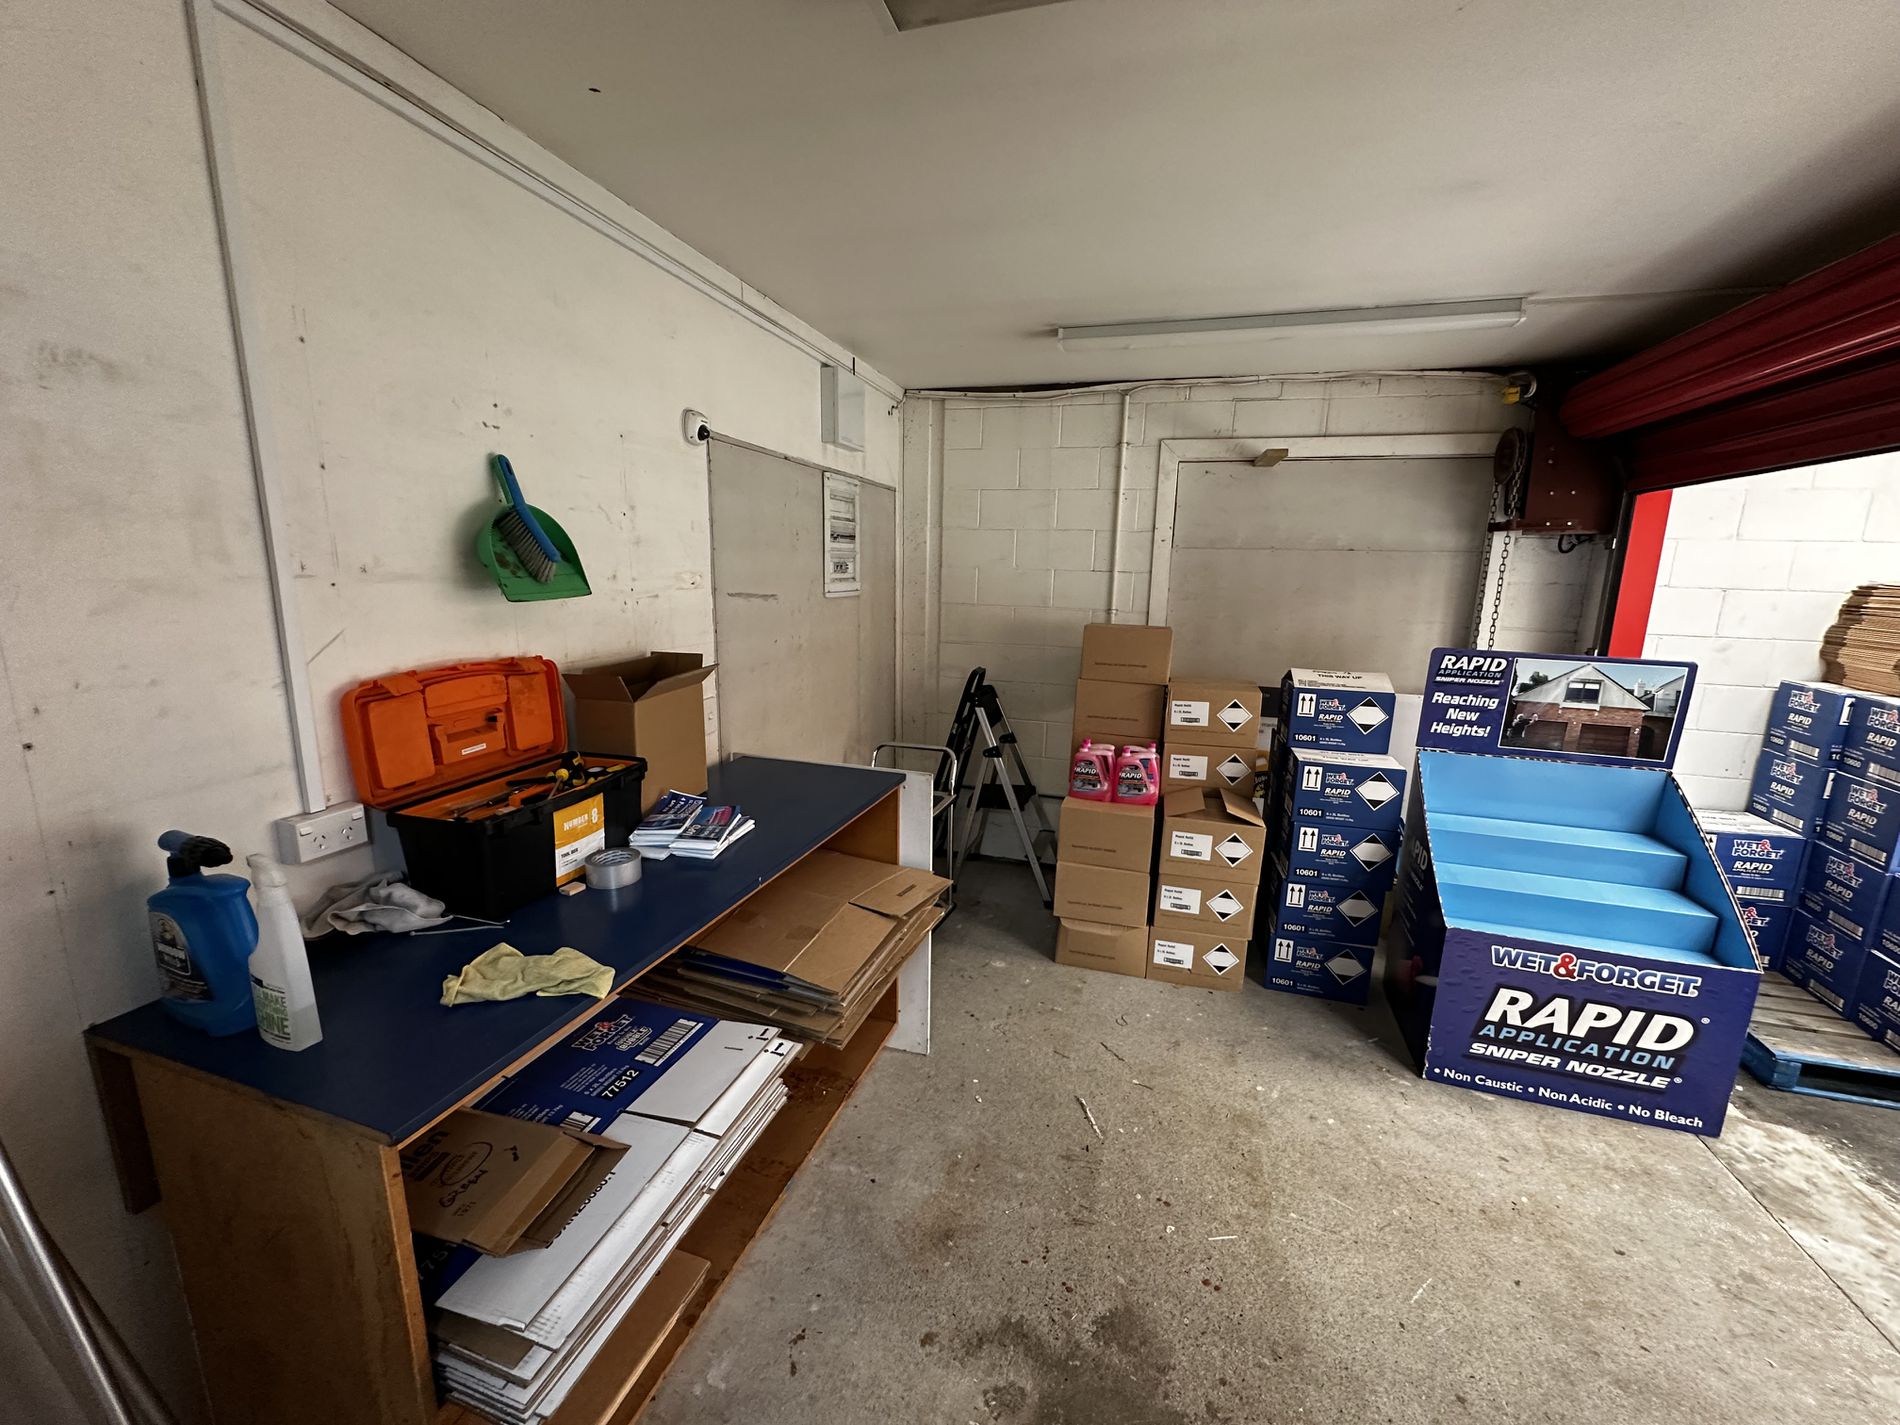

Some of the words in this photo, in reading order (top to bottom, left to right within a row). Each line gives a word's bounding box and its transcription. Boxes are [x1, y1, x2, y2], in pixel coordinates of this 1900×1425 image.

[1440, 655, 1507, 671] RAPID
[1438, 668, 1502, 678] APPLICATION
[1434, 676, 1466, 684] SNIPER
[1431, 692, 1499, 709] Reaching
[1445, 708, 1479, 721] New
[1787, 713, 1812, 725] RAPID
[1430, 722, 1491, 737] Heights!
[1294, 734, 1316, 742] 10601
[1867, 732, 1897, 748] RAPID
[1324, 787, 1351, 796] RAPID
[1770, 781, 1795, 796] RAPID
[592, 808, 598, 824] 8
[1299, 808, 1322, 817] 10601
[1848, 808, 1878, 826] RAPID
[1320, 848, 1346, 857] RAPID
[1732, 847, 1785, 860] FORGET
[1296, 868, 1318, 876] 10601
[1733, 860, 1774, 871] RAPID
[1824, 880, 1853, 898] RAPID
[1307, 904, 1333, 913] RAPID
[1283, 924, 1305, 932] 10601
[1295, 960, 1321, 969] RAPID
[1805, 948, 1834, 970] RAPID
[1272, 977, 1294, 986] 10601
[1484, 987, 1695, 1052] RAPID
[1478, 1024, 1675, 1070] APPLICATION
[1469, 1043, 1560, 1069] SNIPER
[1565, 1059, 1671, 1089] NOZZLE
[601, 1069, 640, 1099] 77512
[1444, 1068, 1472, 1082] Non
[1474, 1074, 1524, 1093] Caustic
[1538, 1086, 1567, 1102] Non
[1570, 1092, 1613, 1111] Acidic
[1628, 1104, 1650, 1118] No
[1654, 1109, 1703, 1128] Bleach
